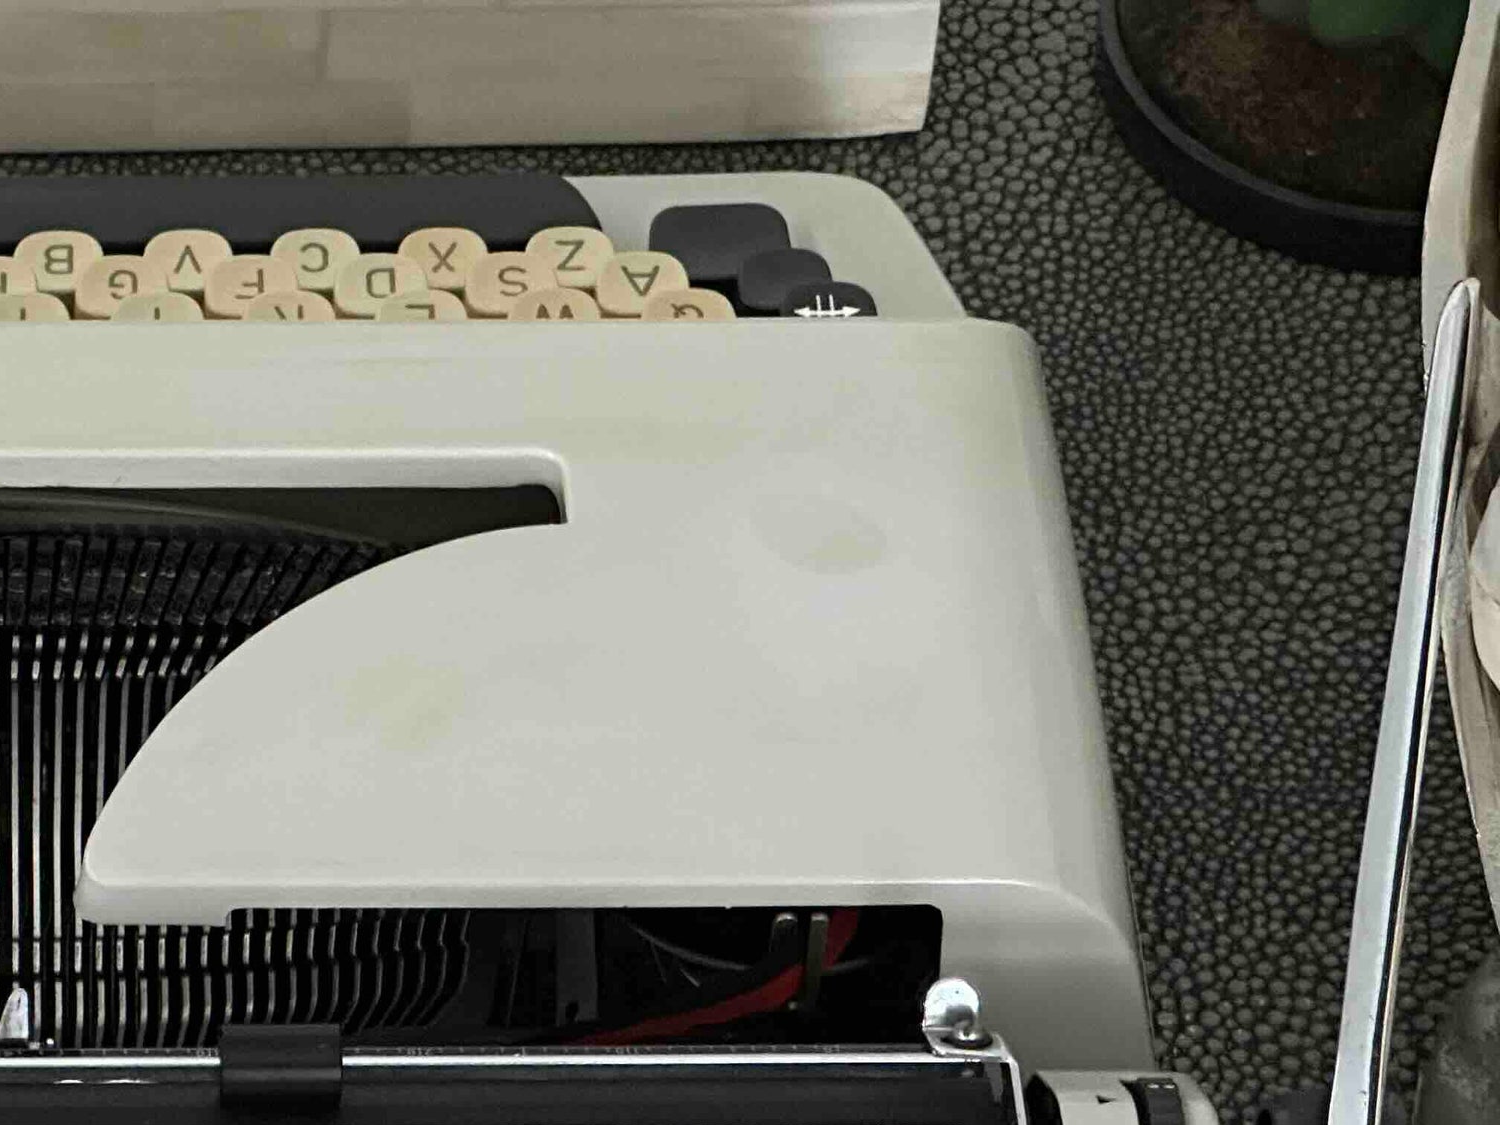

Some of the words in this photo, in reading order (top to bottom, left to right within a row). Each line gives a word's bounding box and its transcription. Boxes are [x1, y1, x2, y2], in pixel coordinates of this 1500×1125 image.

[44, 244, 74, 275] B
[173, 244, 203, 275] V
[300, 242, 330, 273] C
[428, 241, 458, 273] X
[554, 239, 586, 271] Z
[108, 269, 139, 300] G
[234, 267, 265, 300] F
[365, 267, 397, 299] D
[497, 265, 529, 298] S
[620, 264, 661, 297] A
